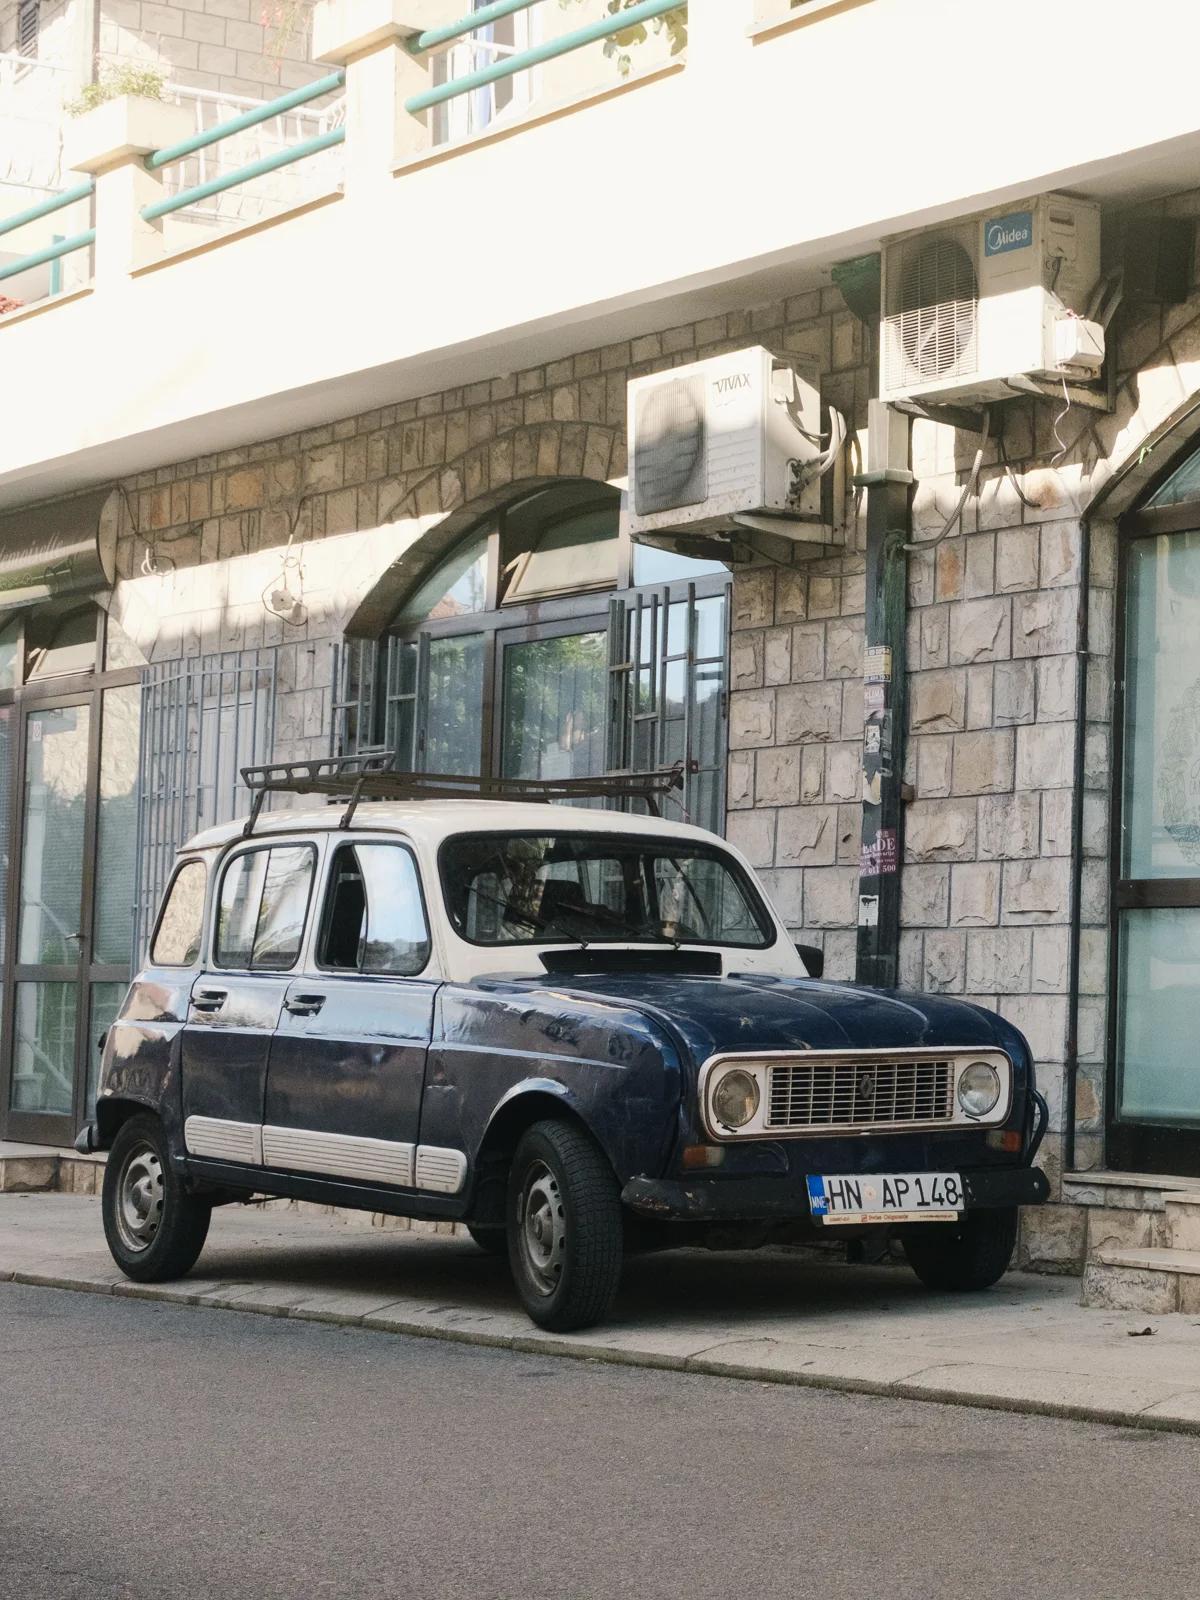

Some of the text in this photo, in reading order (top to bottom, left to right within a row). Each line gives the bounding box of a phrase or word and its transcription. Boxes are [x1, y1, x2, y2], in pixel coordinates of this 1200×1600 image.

[990, 227, 1028, 247] Midea
[712, 373, 751, 392] VIVAX
[882, 864, 896, 873] 500
[828, 1179, 863, 1210] HN
